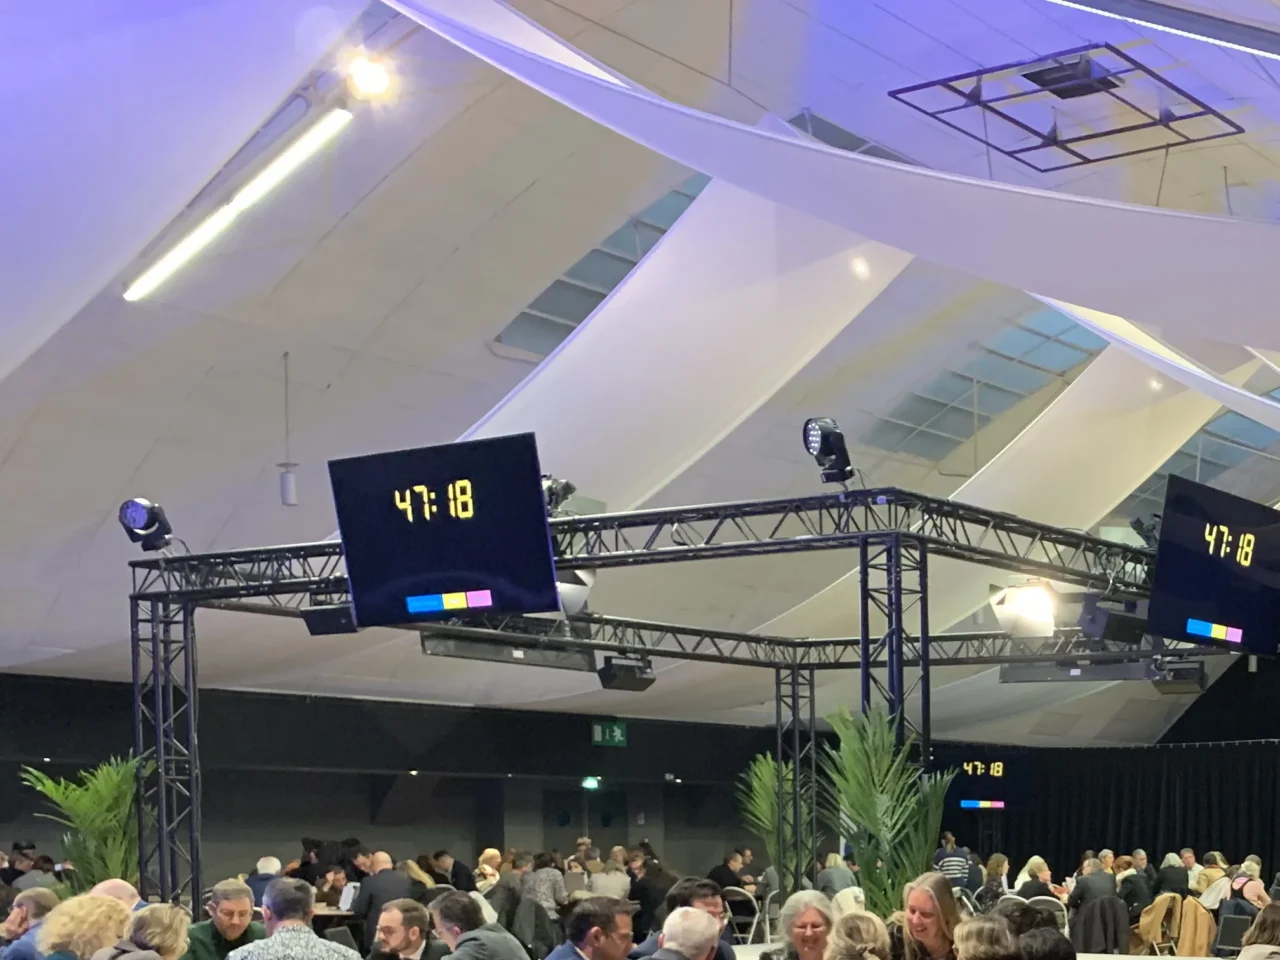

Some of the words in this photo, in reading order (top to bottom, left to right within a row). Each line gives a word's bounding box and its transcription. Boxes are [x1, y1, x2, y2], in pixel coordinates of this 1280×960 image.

[395, 479, 474, 523] 47:18
[1204, 522, 1256, 567] 47:18
[963, 761, 1004, 777] 47:18
